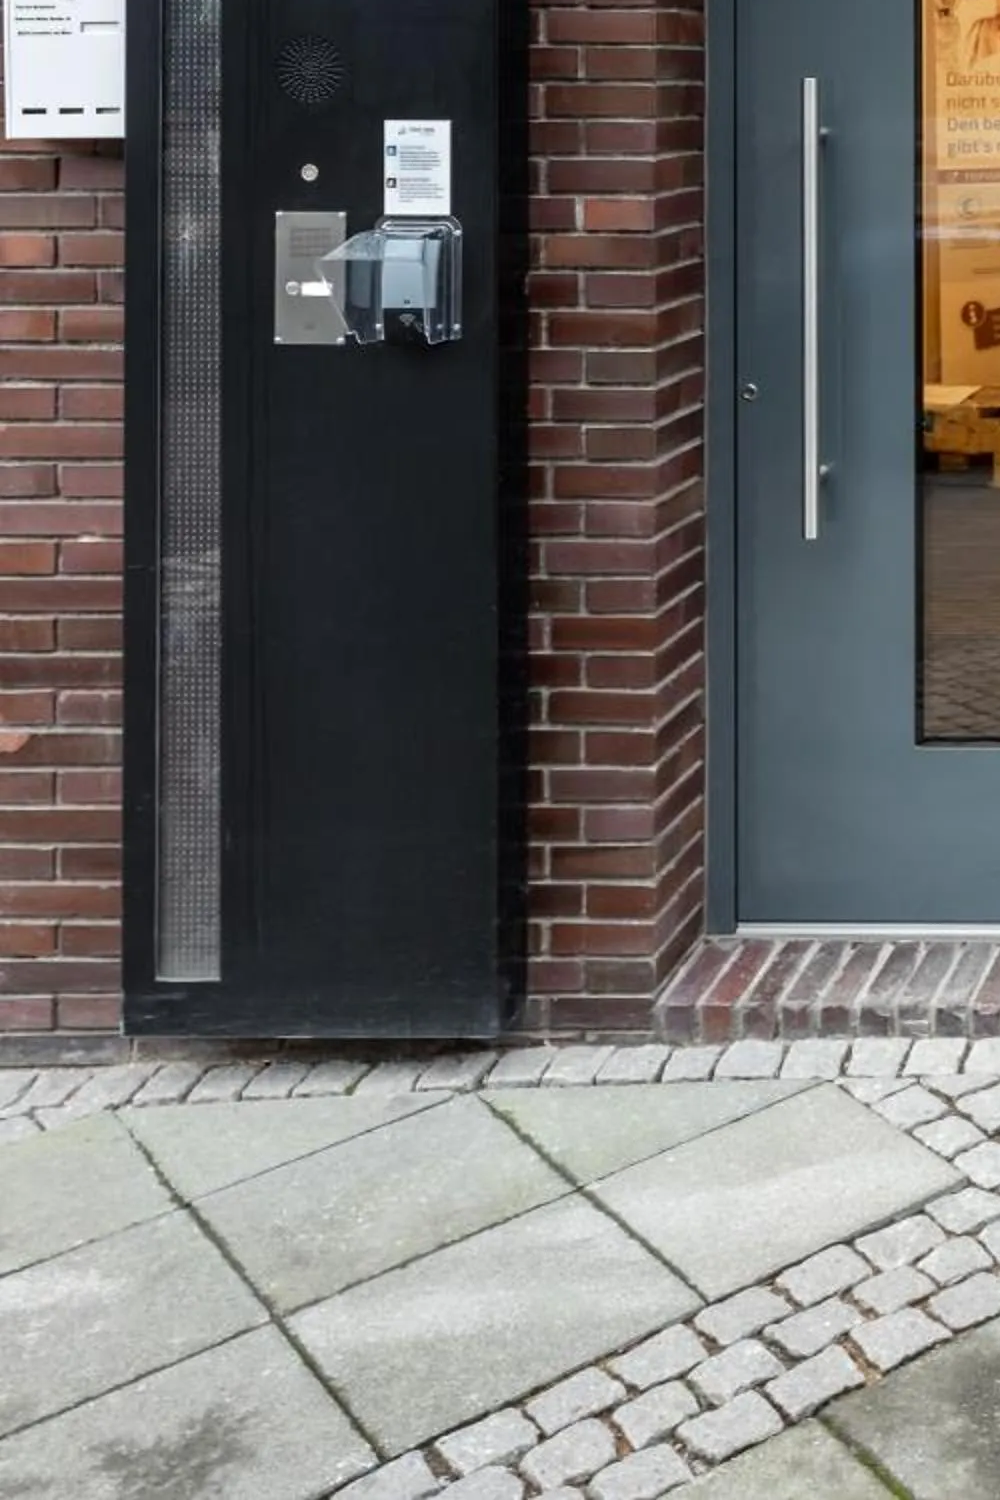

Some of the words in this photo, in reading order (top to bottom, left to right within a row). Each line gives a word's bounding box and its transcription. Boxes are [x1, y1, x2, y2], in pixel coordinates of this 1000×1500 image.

[946, 95, 987, 110] nicht
[947, 116, 979, 132] Den
[947, 138, 993, 158] gibt's
